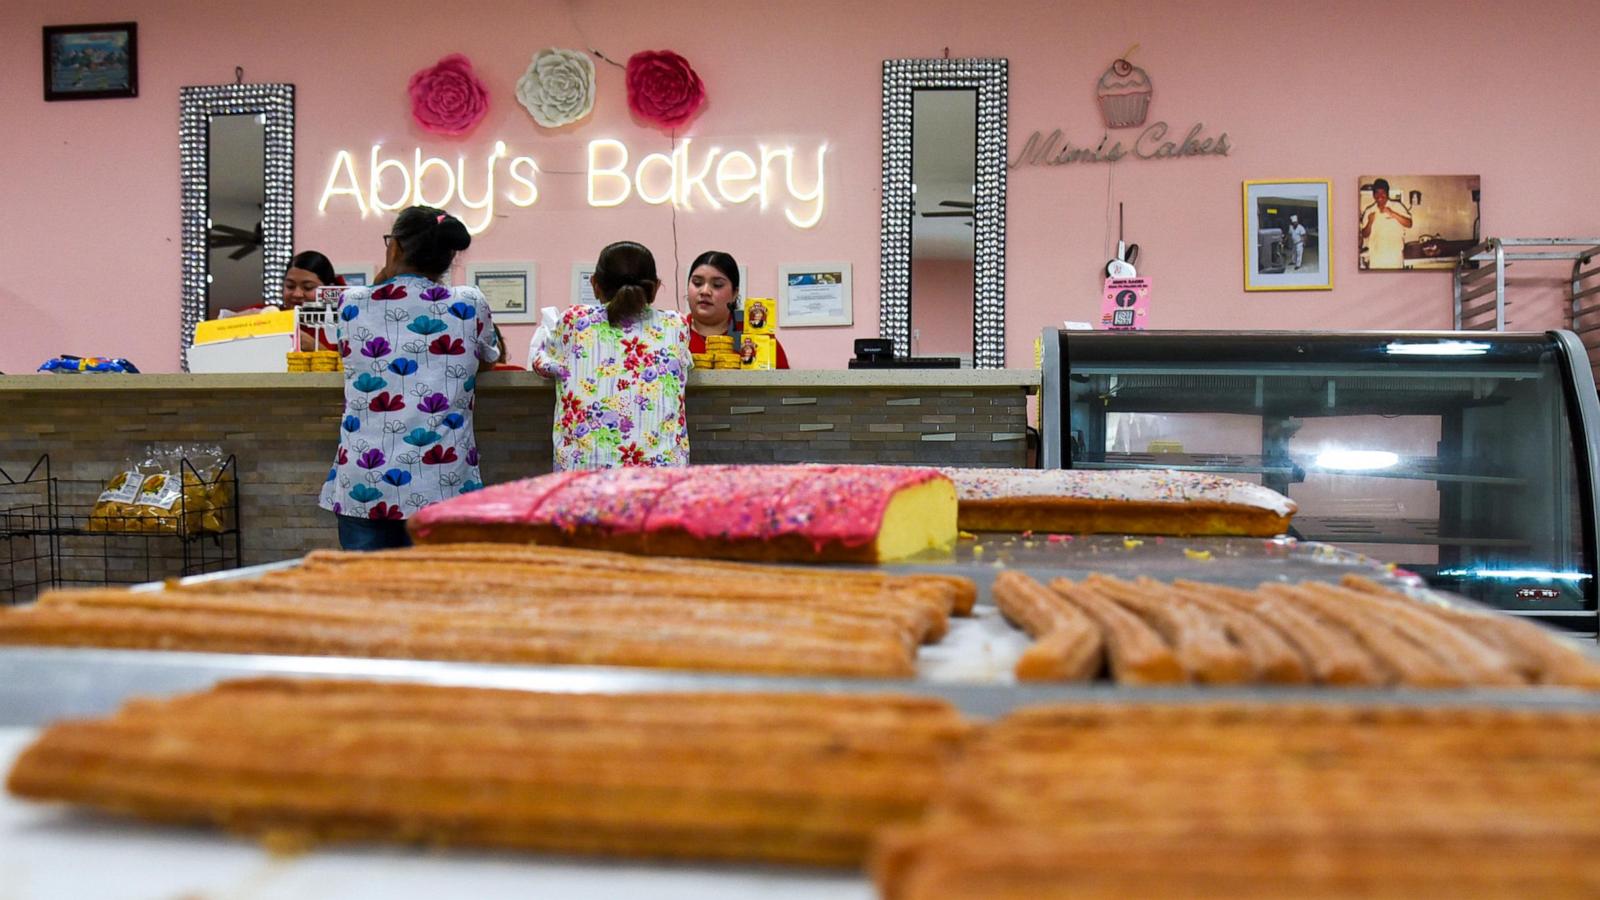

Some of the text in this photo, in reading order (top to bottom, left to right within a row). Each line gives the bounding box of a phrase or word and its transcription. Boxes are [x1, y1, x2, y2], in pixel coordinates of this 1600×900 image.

[1135, 121, 1231, 160] Cakes
[317, 137, 830, 236] Abby's Bakery
